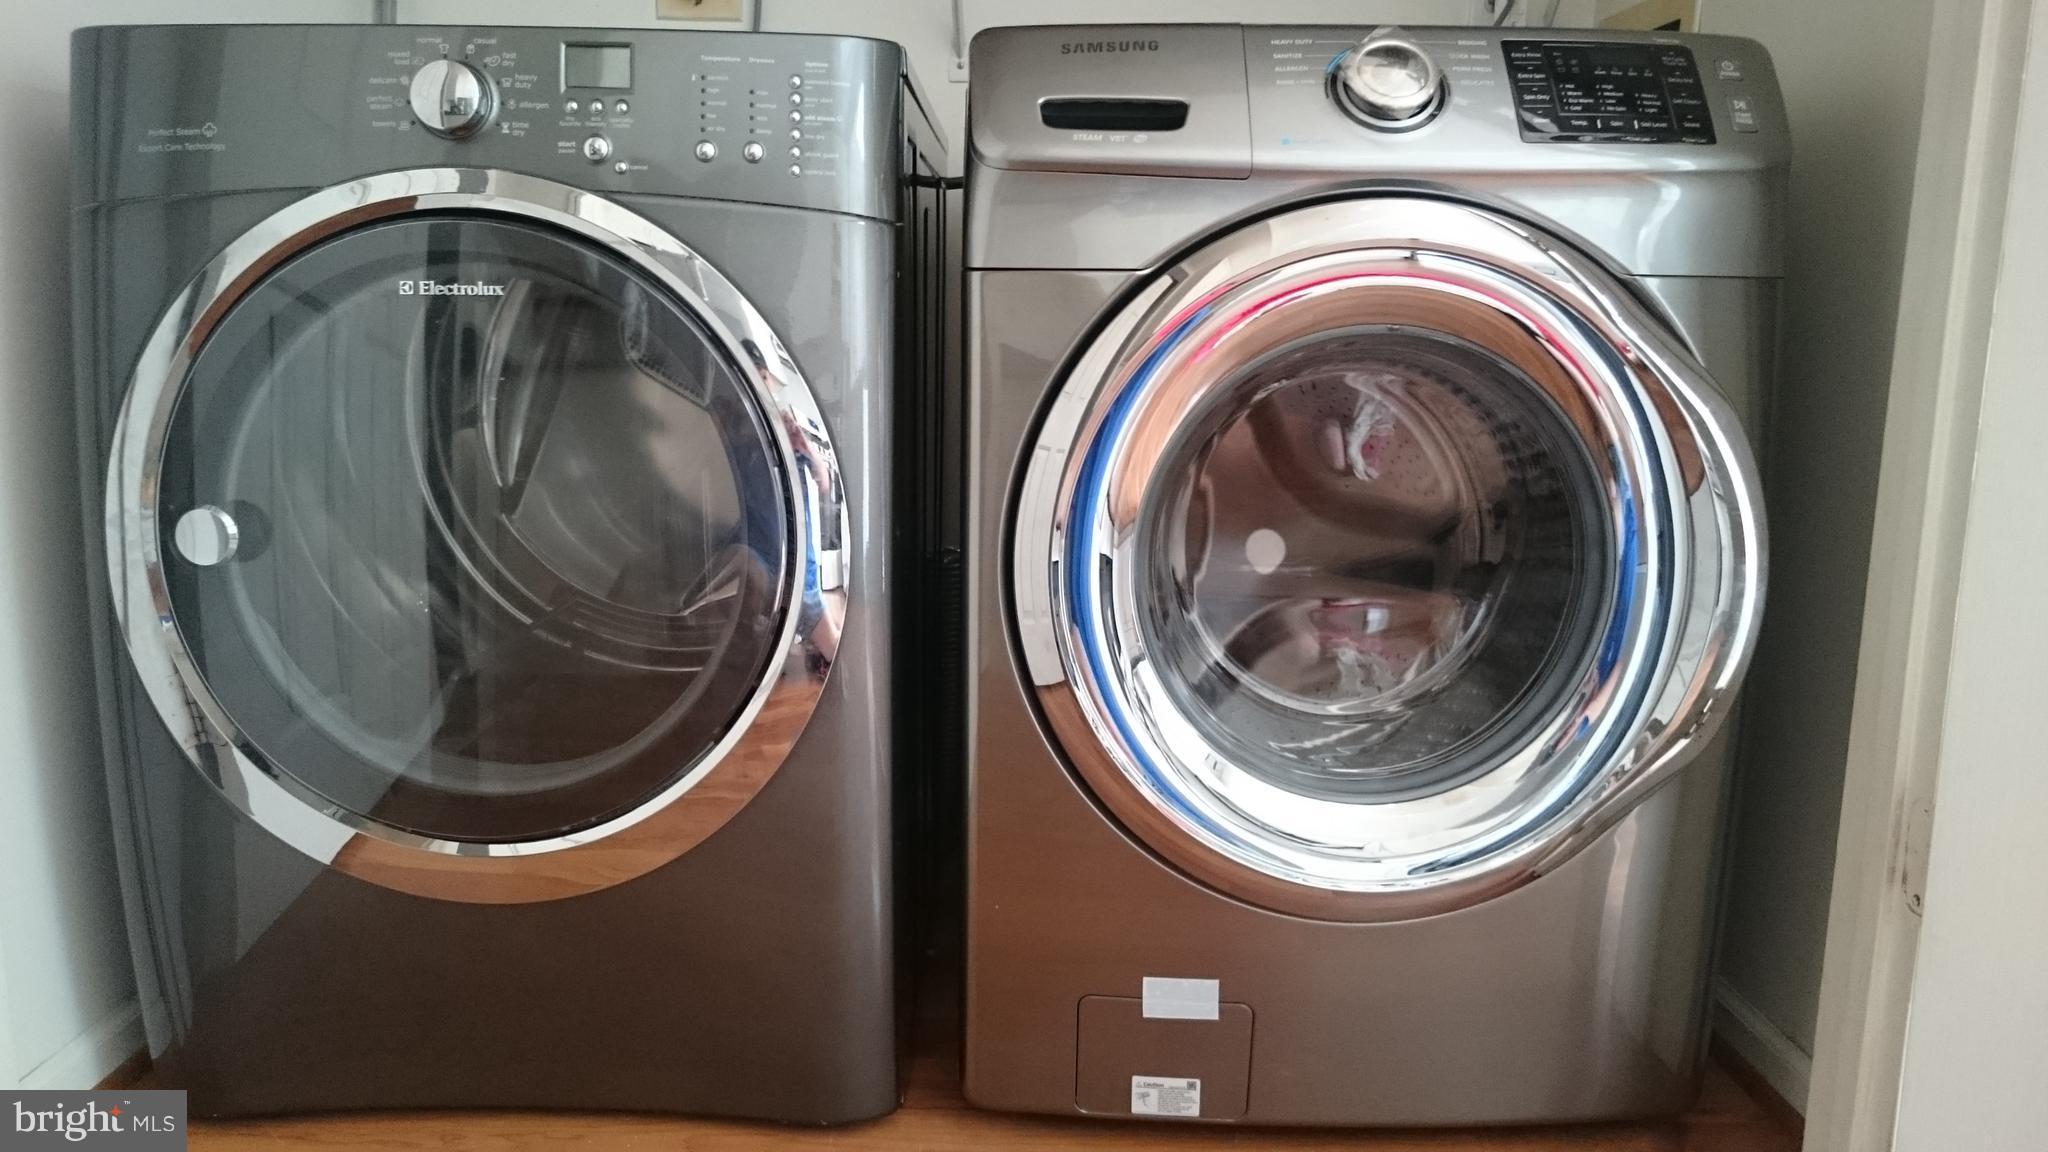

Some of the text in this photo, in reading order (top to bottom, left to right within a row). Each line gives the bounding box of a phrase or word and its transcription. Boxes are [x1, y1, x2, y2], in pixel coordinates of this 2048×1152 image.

[1061, 40, 1160, 55] SAMSUNG
[502, 59, 515, 68] dry
[701, 55, 741, 63] Temperature
[515, 73, 538, 82] heavy
[1072, 134, 1104, 142] STEAM
[419, 280, 504, 297] Electrolux
